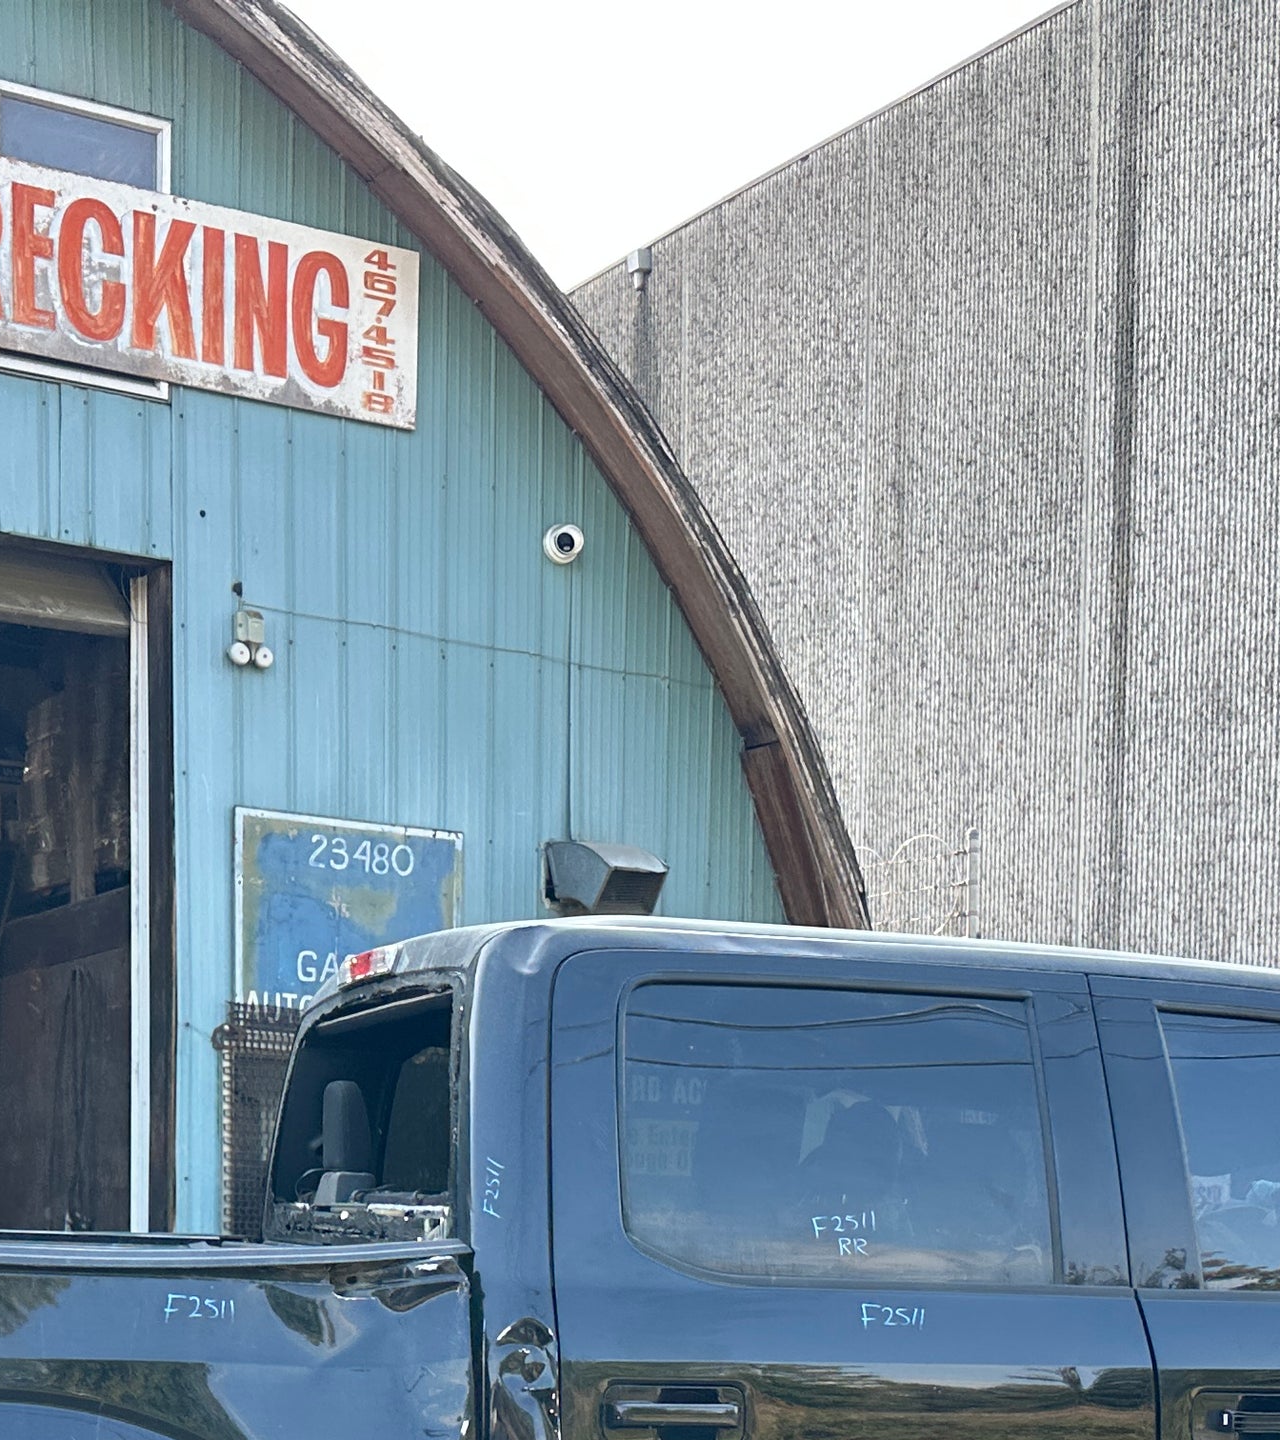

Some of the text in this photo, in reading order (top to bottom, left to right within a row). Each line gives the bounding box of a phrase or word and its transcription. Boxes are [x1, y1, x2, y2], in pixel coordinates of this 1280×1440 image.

[308, 833, 415, 877] 23480
[296, 949, 340, 985] GA
[482, 1156, 505, 1219] F2511
[811, 1210, 876, 1239] F2511
[163, 1293, 236, 1324] F2511
[860, 1303, 925, 1330] F2511
